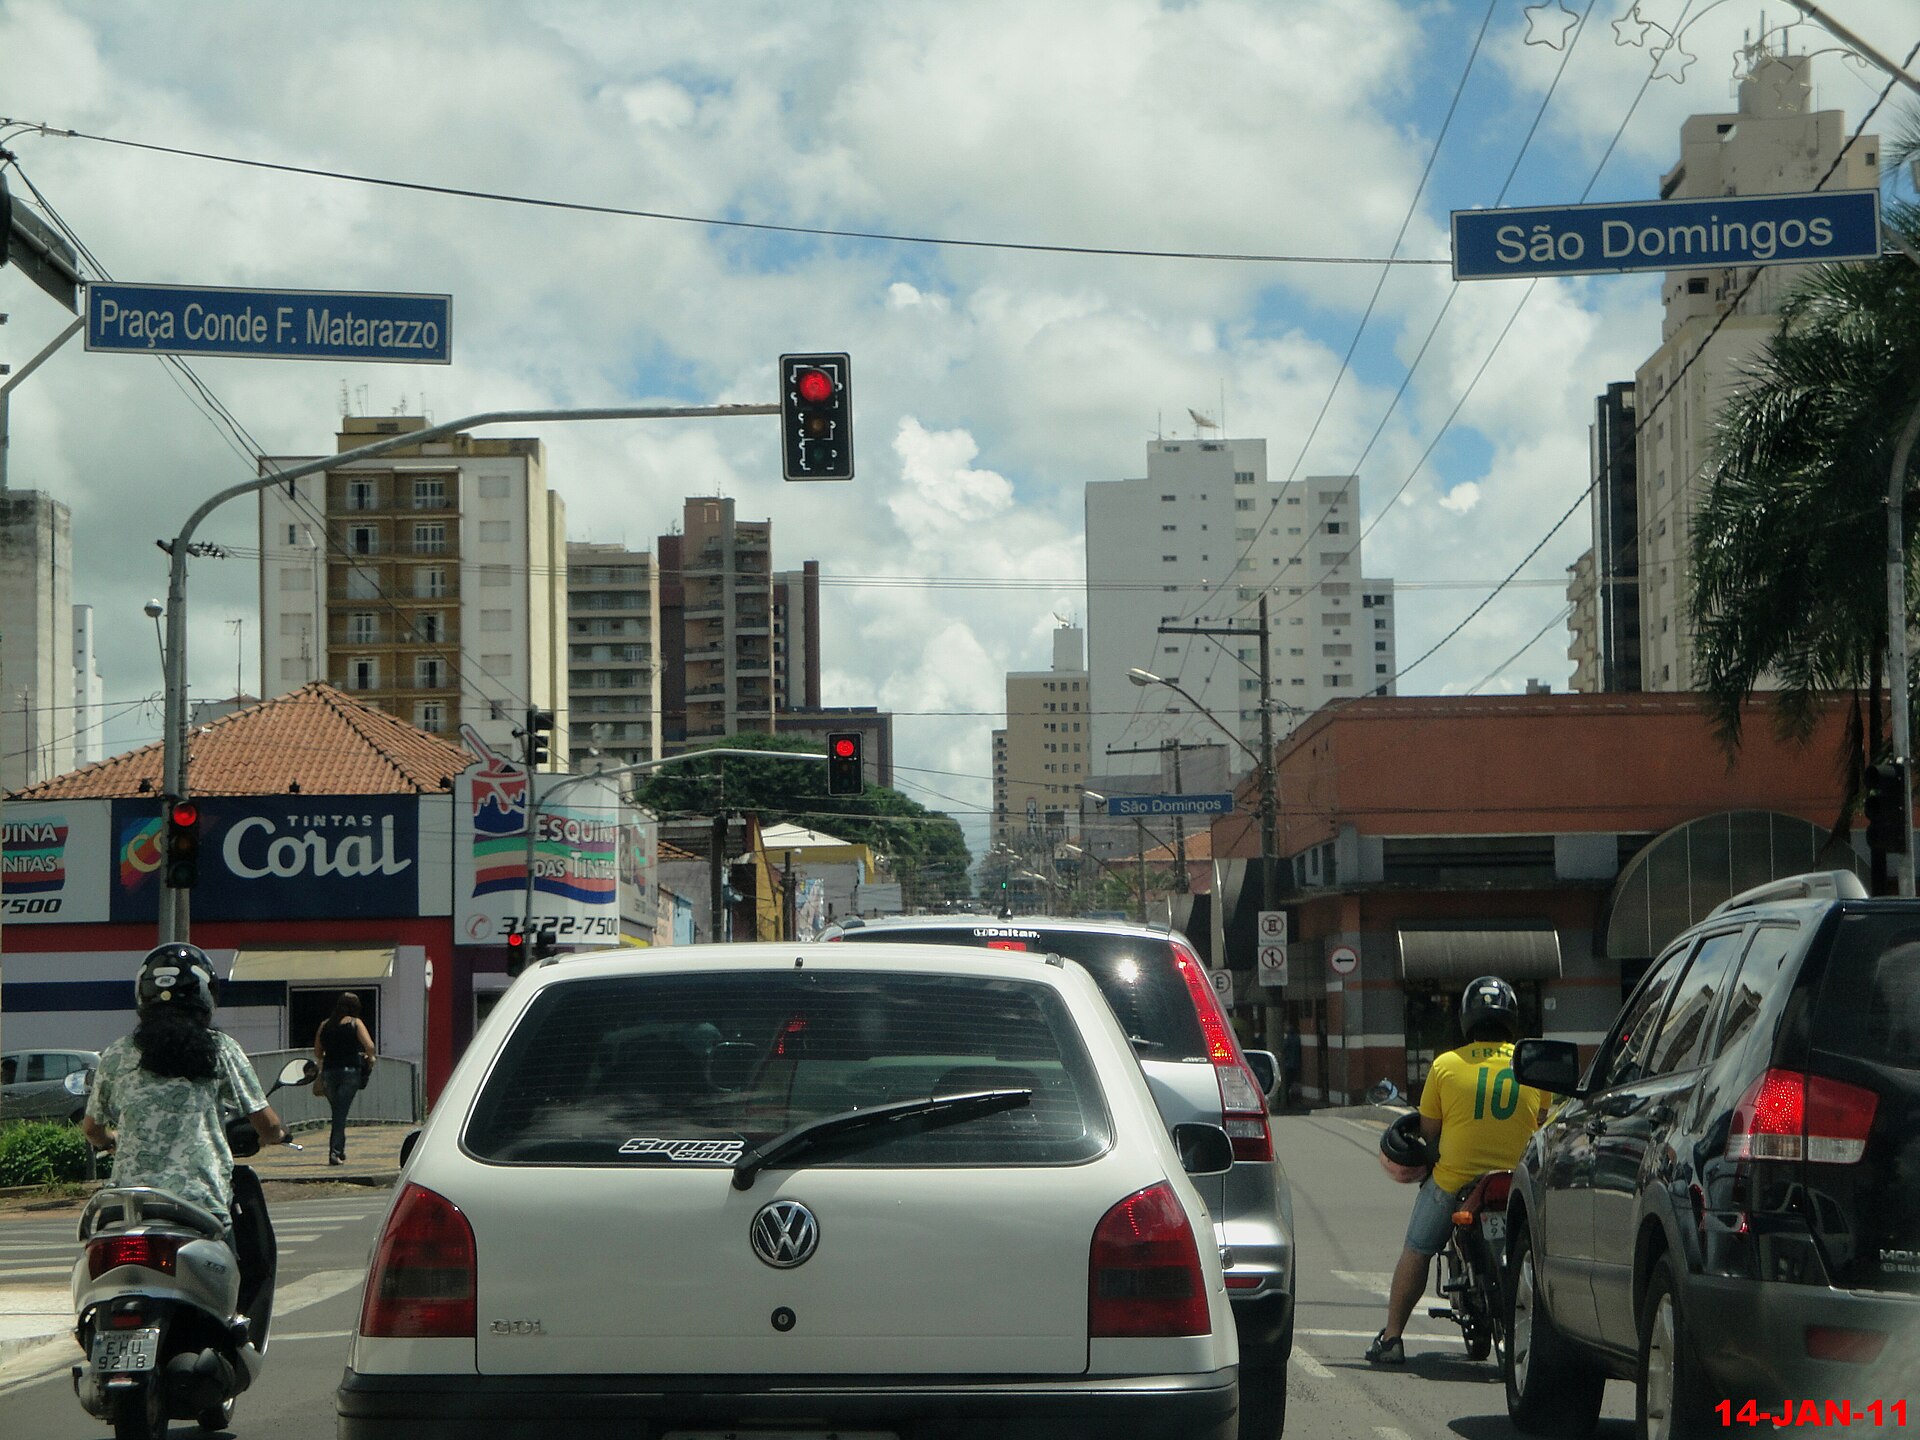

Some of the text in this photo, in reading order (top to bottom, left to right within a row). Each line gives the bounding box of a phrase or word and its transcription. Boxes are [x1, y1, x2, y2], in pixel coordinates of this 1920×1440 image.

[1496, 215, 1833, 263] São Domingos
[100, 299, 439, 349] Praça Conde F. Matarazzo
[1120, 799, 1222, 813] São Domingos
[287, 815, 373, 827] TINTAS
[222, 814, 412, 879] Coral
[535, 860, 566, 877] DAS
[1215, 976, 1224, 990] E
[1474, 1067, 1521, 1120] 10
[106, 1340, 142, 1356] EHU
